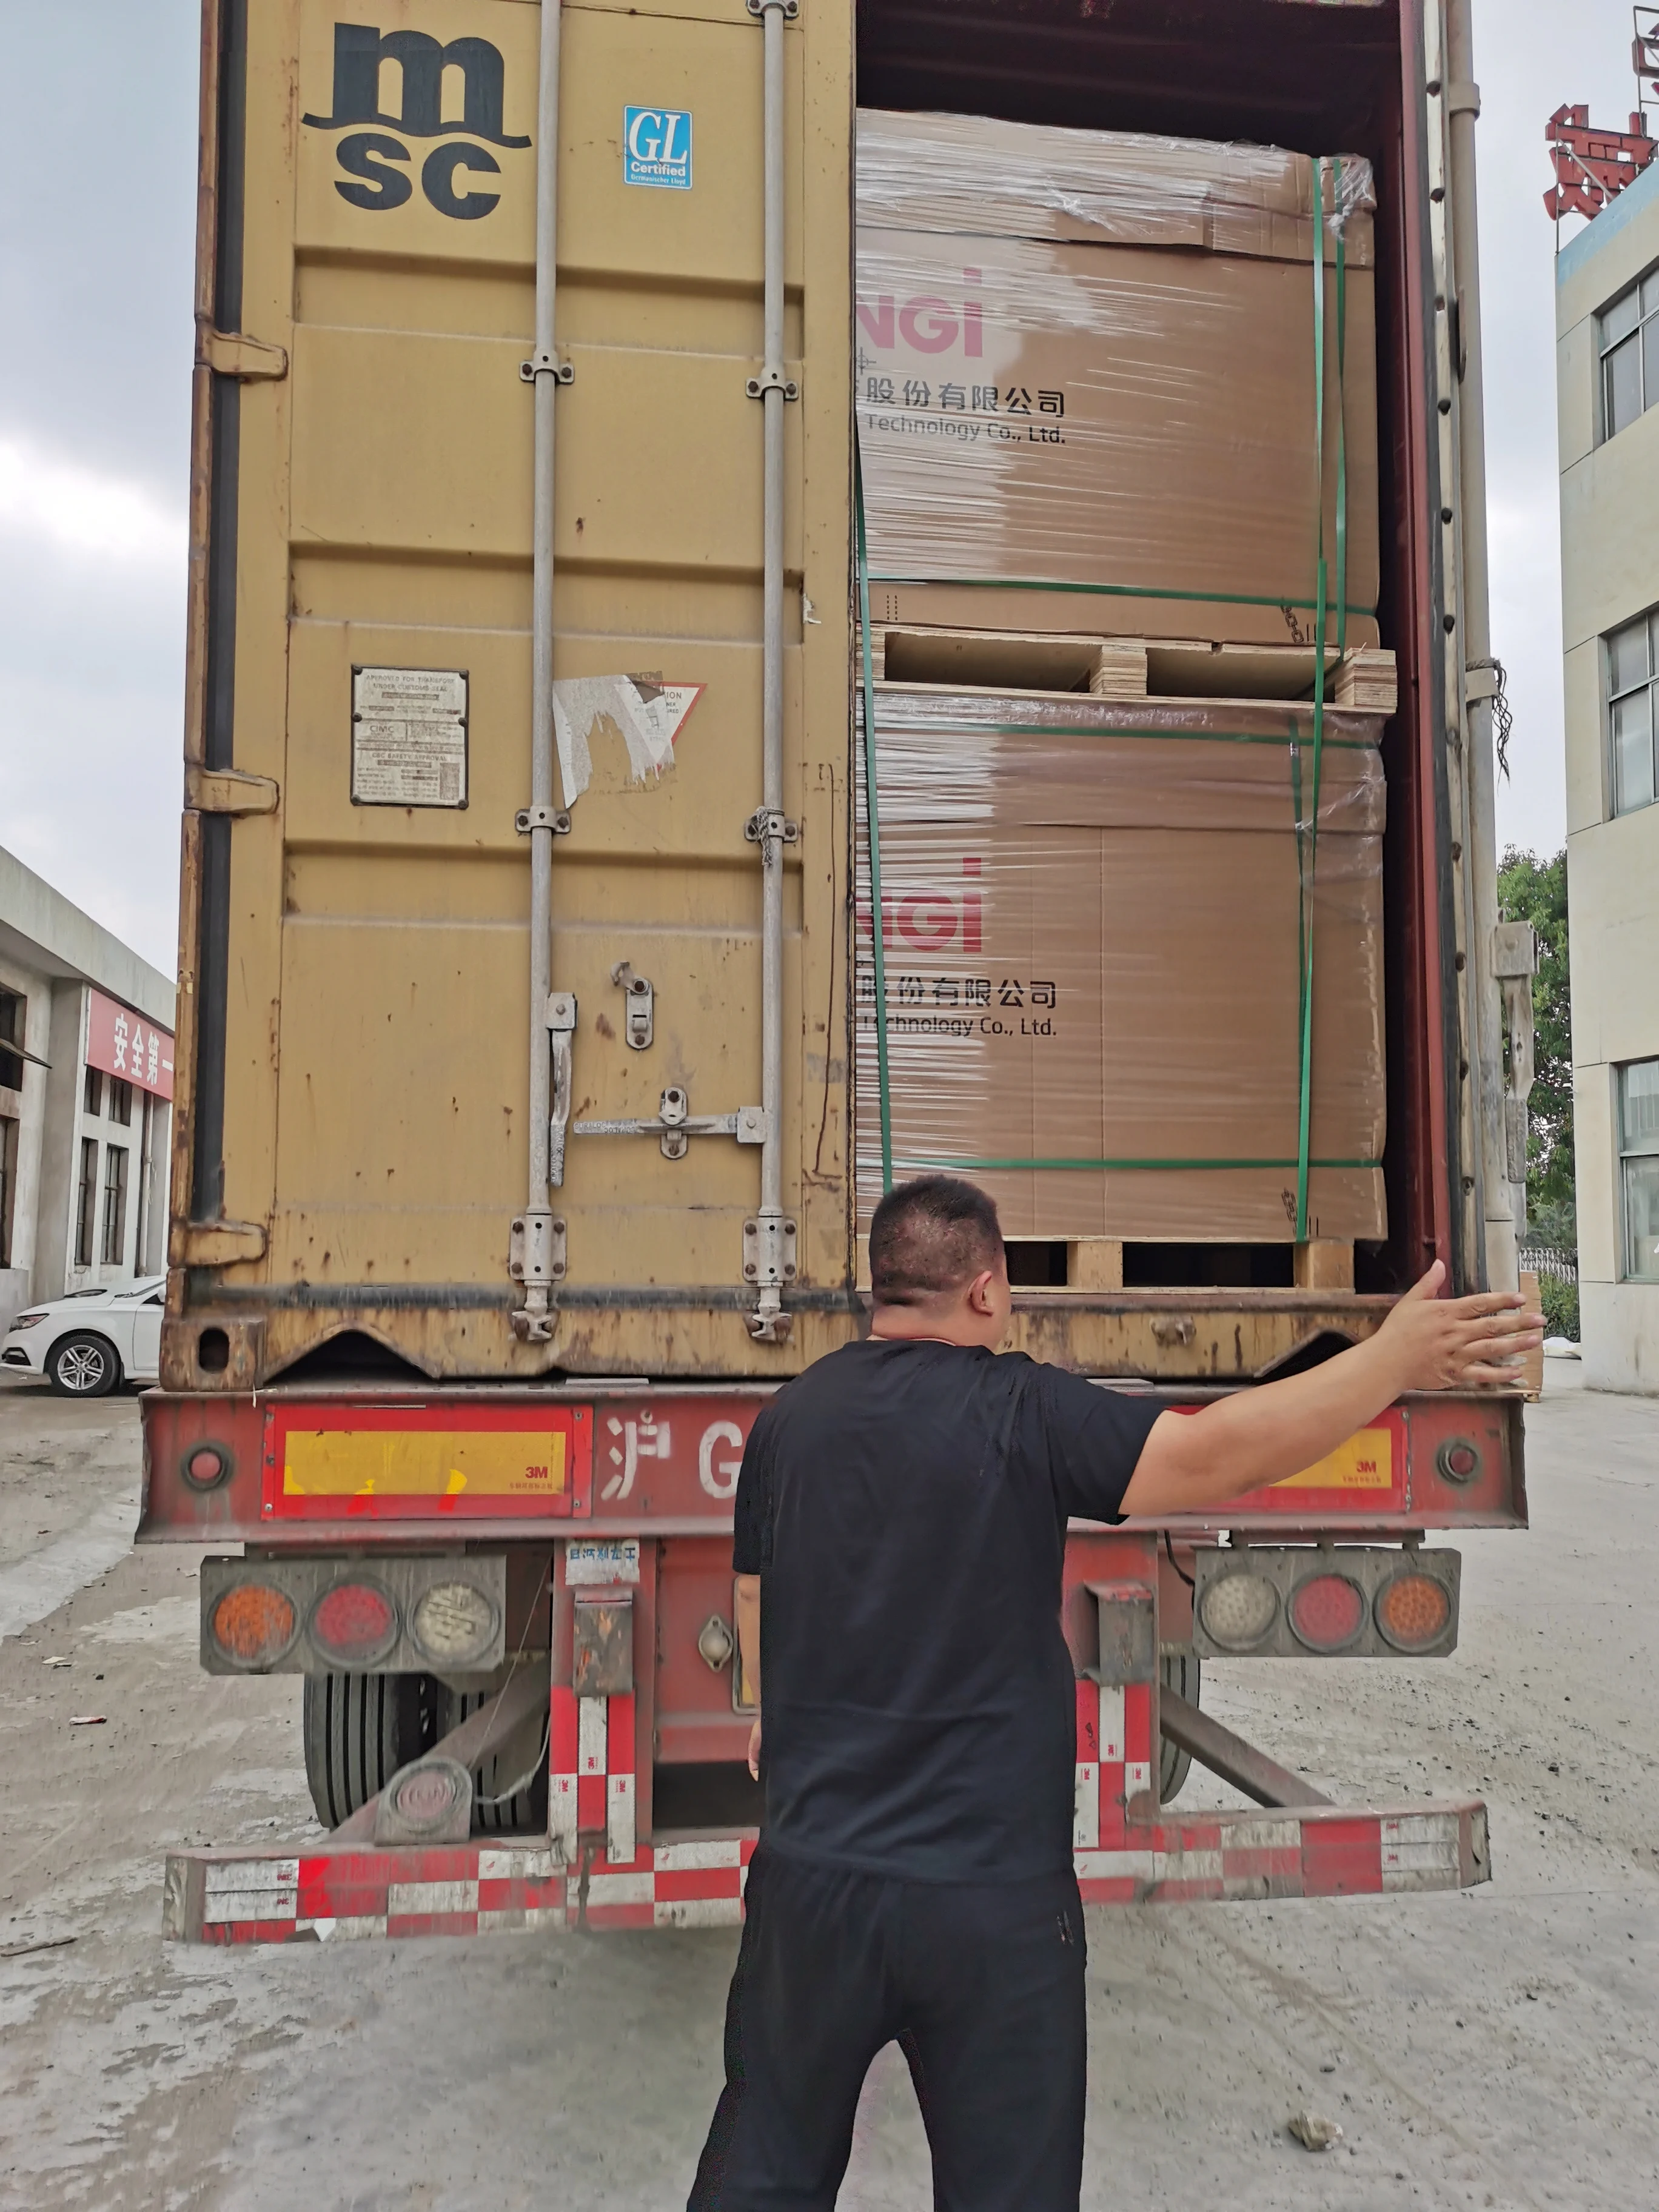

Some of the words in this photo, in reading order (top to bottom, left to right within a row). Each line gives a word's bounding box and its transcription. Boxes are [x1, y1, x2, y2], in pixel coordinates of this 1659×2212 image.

[629, 112, 688, 164] GL
[631, 161, 686, 176] Certified
[856, 377, 1065, 418] 股份有限公司
[866, 413, 980, 441] Technology
[987, 423, 1021, 443] Co.,
[1029, 426, 1065, 444] Ltd.
[862, 1014, 974, 1036] Tchnology
[980, 1016, 1013, 1036] Co.,
[1021, 1017, 1057, 1036] Ltd.
[113, 1013, 173, 1085] 安全第一
[525, 1466, 548, 1478] 3M
[1356, 1461, 1376, 1473] 3M
[1084, 1768, 1090, 1780] 3M
[1135, 1768, 1142, 1780] 3M
[561, 1779, 569, 1792] 3M
[619, 1780, 626, 1793] 3M
